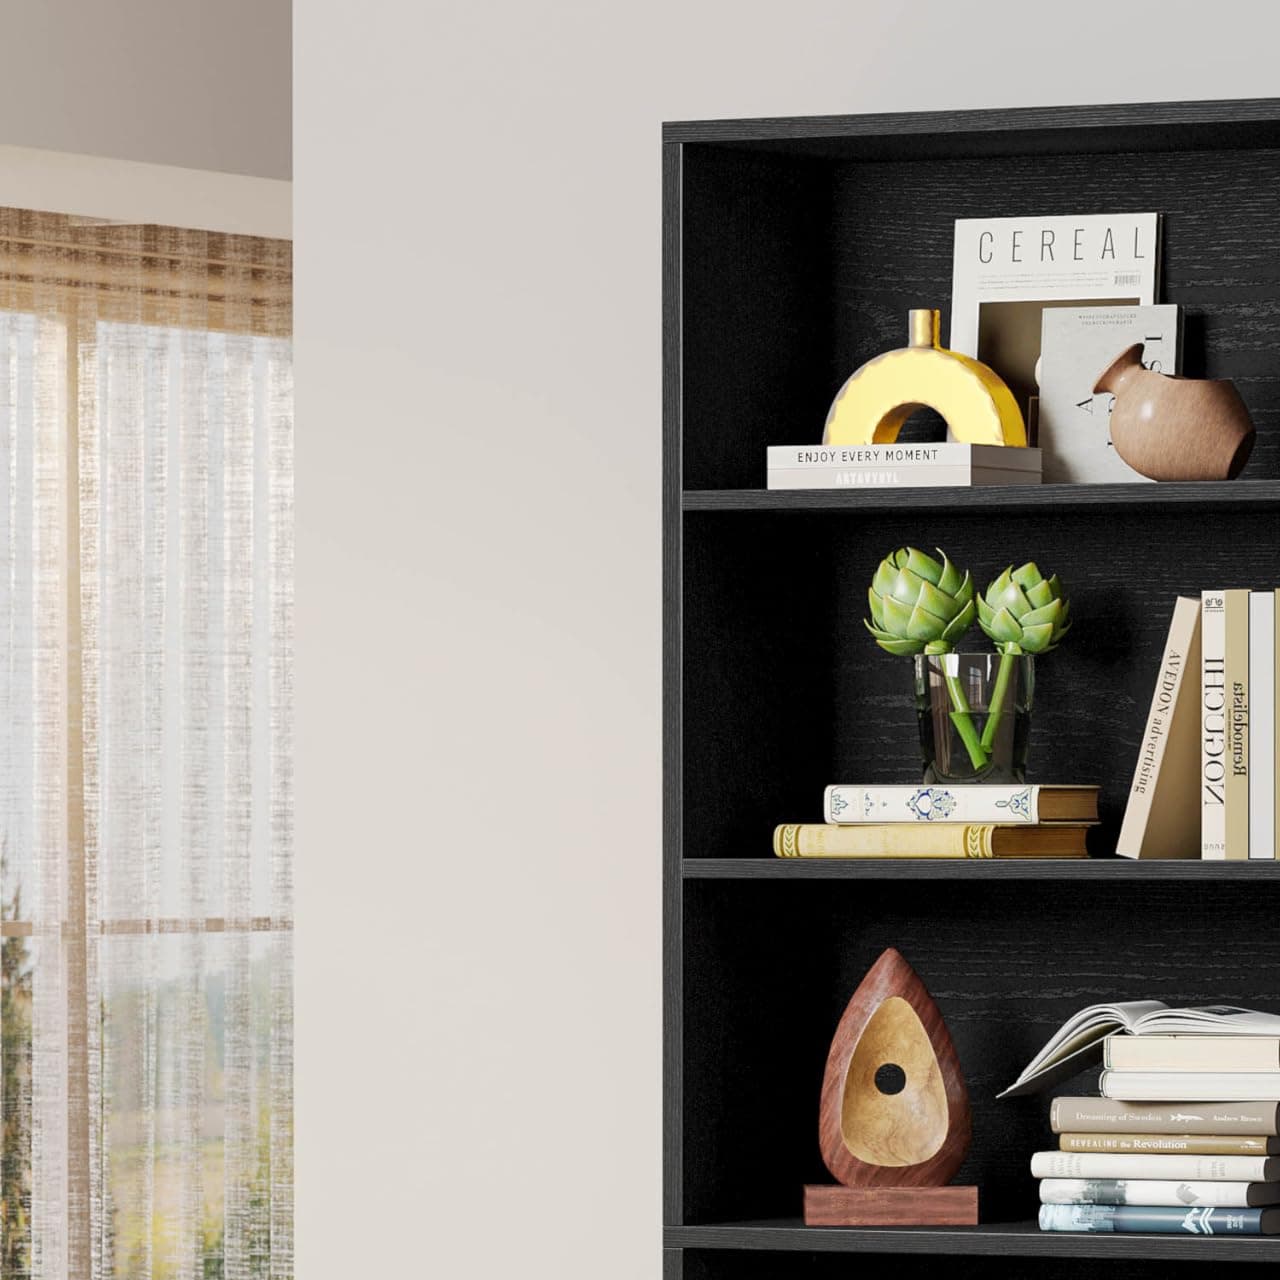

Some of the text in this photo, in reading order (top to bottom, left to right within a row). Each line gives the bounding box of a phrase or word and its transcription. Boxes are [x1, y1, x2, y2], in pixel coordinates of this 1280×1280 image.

[978, 226, 1145, 264] CEREAL
[797, 449, 939, 463] ENJOY EVERY MOMENT
[1134, 650, 1182, 794] AVEDON advertising
[1133, 1139, 1187, 1149] Revolution
